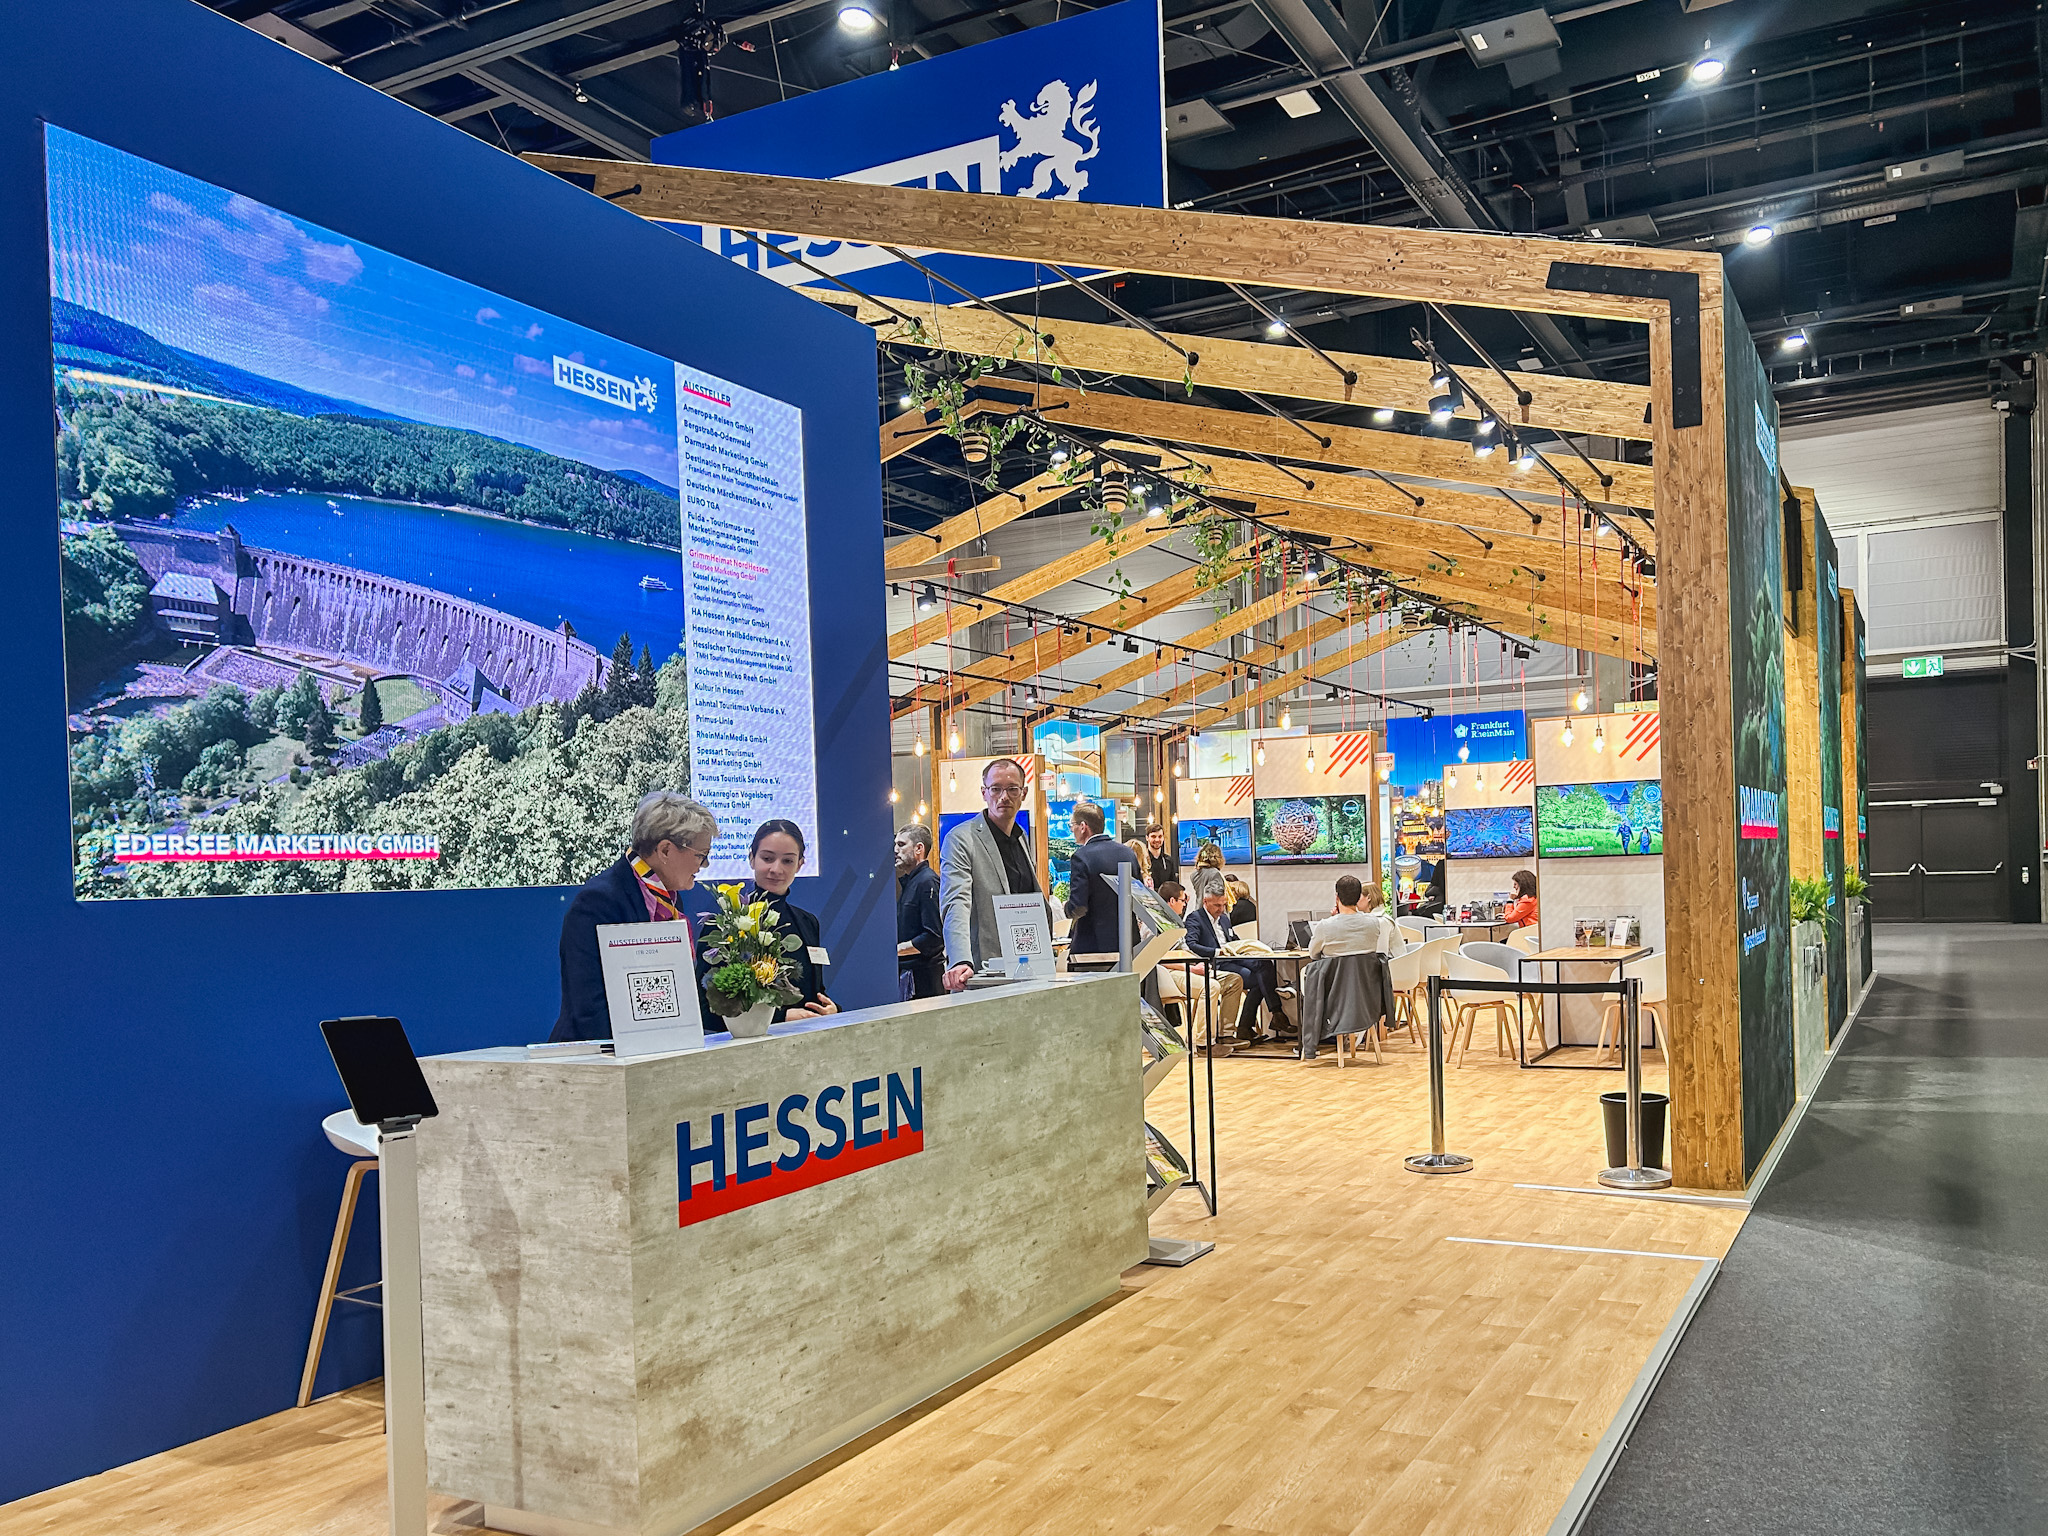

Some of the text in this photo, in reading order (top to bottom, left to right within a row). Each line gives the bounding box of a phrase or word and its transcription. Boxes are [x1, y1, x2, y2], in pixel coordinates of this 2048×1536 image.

[558, 363, 632, 404] HESSEN
[683, 380, 731, 406] AUSSTELLER
[683, 403, 754, 434] Ameropa-Reisen GmbH
[683, 419, 751, 448] Bergstraße-Odenwald
[684, 435, 768, 469] Darmstadt Marketing GmbH
[685, 451, 779, 488] Destination FrankfurtRheinMain
[686, 478, 716, 494] Deutsche
[716, 487, 760, 507] Märchenstraße
[686, 495, 720, 511] EURO TGA
[687, 511, 705, 523] Fulda
[743, 526, 755, 536] und
[687, 521, 759, 547] Marketingmanagement
[736, 545, 753, 555] GmbH
[689, 549, 769, 575] GrimmHeimat NordHessen
[692, 561, 757, 581] Edersee Marketing GmbH
[692, 571, 729, 586] Kassel Airport
[693, 582, 754, 601] Kassel Marketing GmbH
[691, 607, 770, 629] HA Hessen Agentur GmbH
[692, 623, 791, 648] Hessischer Heilbäderverband e.V.
[692, 640, 792, 663] Hessischer Tourismusverband e.V.
[693, 666, 723, 677] Kochwelt
[724, 670, 742, 680] Mirko
[758, 675, 777, 685] GmbH
[767, 662, 784, 671] Hessen
[694, 682, 714, 693] Kultur
[722, 686, 744, 696] Hessen
[695, 698, 787, 716] Lahntal Tourismus Verband e.V.
[695, 714, 734, 726] Primus-Linie
[1471, 720, 1510, 731] Frankfurt
[696, 730, 768, 744] RheinMainMedia GmbH
[1471, 728, 1515, 739] RheinMain
[697, 746, 754, 758] Spessart Tourismus
[697, 758, 762, 769] und Marketing GmbH
[698, 773, 781, 785] Taunus Touristik Service e.V.
[698, 789, 774, 801] Vulkanregion Vogelsberg
[731, 801, 751, 809] GmbH
[1739, 785, 1779, 829] DRAMATISCH
[730, 816, 752, 825] Village
[114, 833, 440, 857] EDERSEE MARKETING GMBH
[608, 936, 682, 947] AUSSTELLER HESSEN
[676, 1066, 924, 1202] HESSEN
